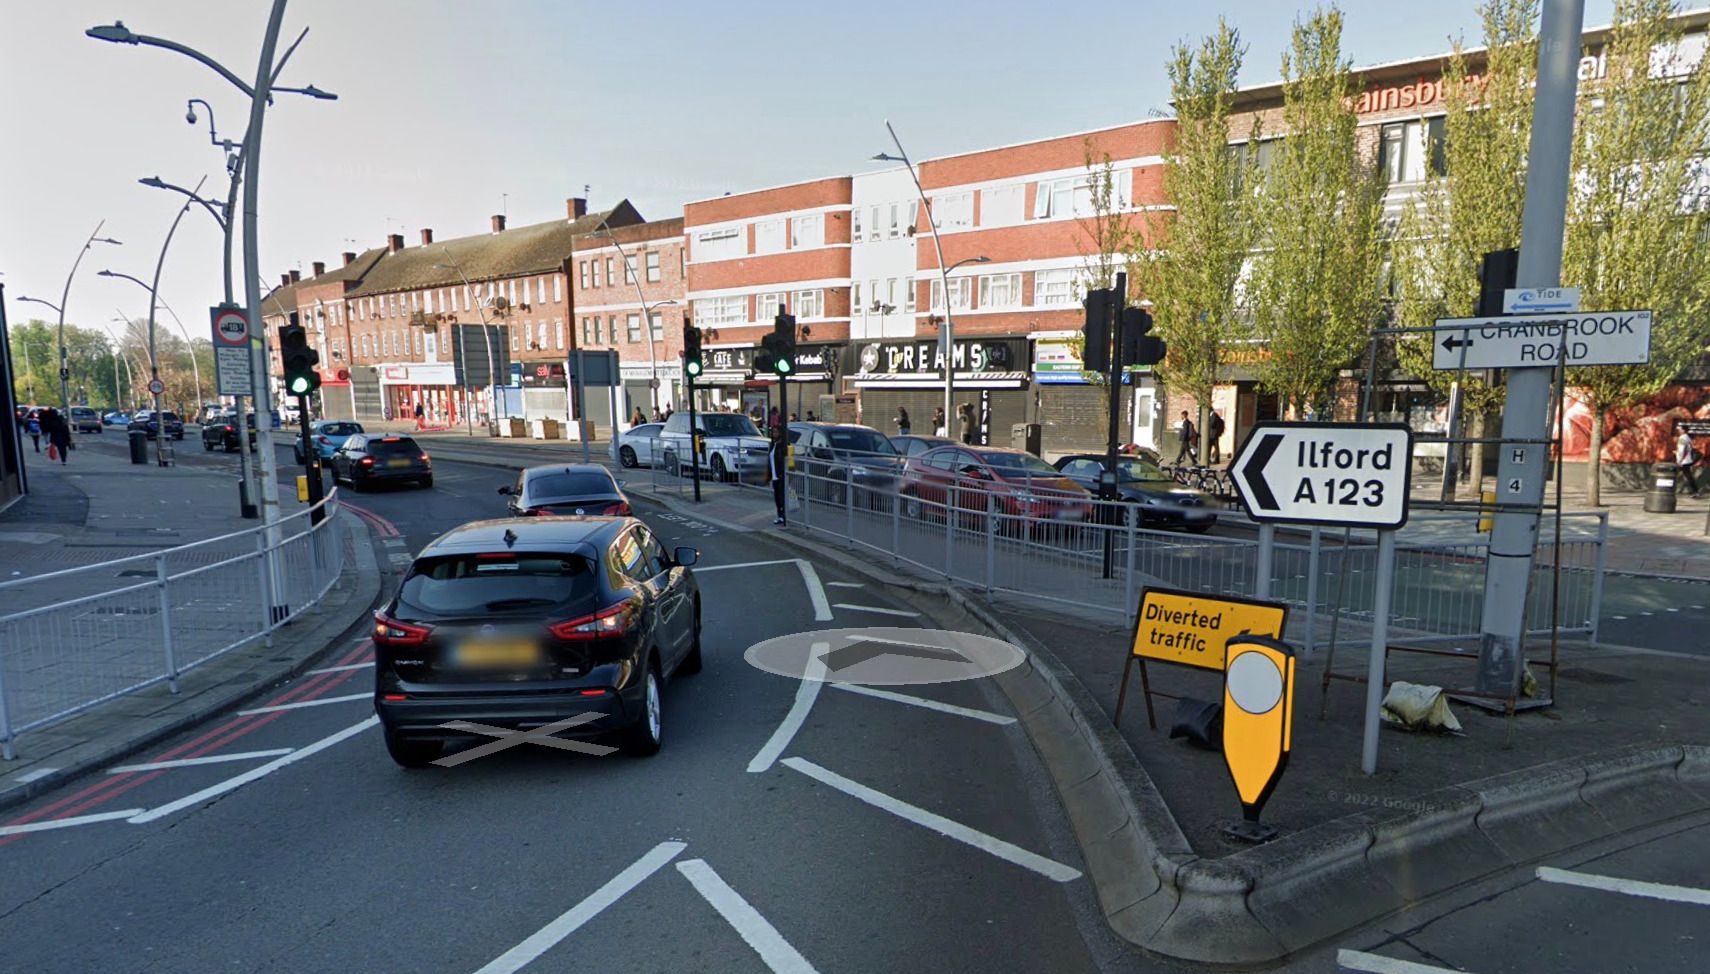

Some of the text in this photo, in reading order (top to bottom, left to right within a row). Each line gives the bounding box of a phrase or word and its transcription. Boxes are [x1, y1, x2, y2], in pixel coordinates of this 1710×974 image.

[1537, 290, 1562, 299] TIDE
[1481, 316, 1635, 340] CRANBROOK
[800, 354, 823, 365] Kebab
[888, 344, 982, 369] CREAMS
[1521, 342, 1588, 361] ROAD
[1298, 441, 1392, 470] Ilford
[1512, 450, 1524, 462] H
[1293, 477, 1385, 507] A123
[1510, 480, 1520, 492] 4
[1146, 603, 1222, 630] Diverted
[1150, 628, 1206, 652] traffic
